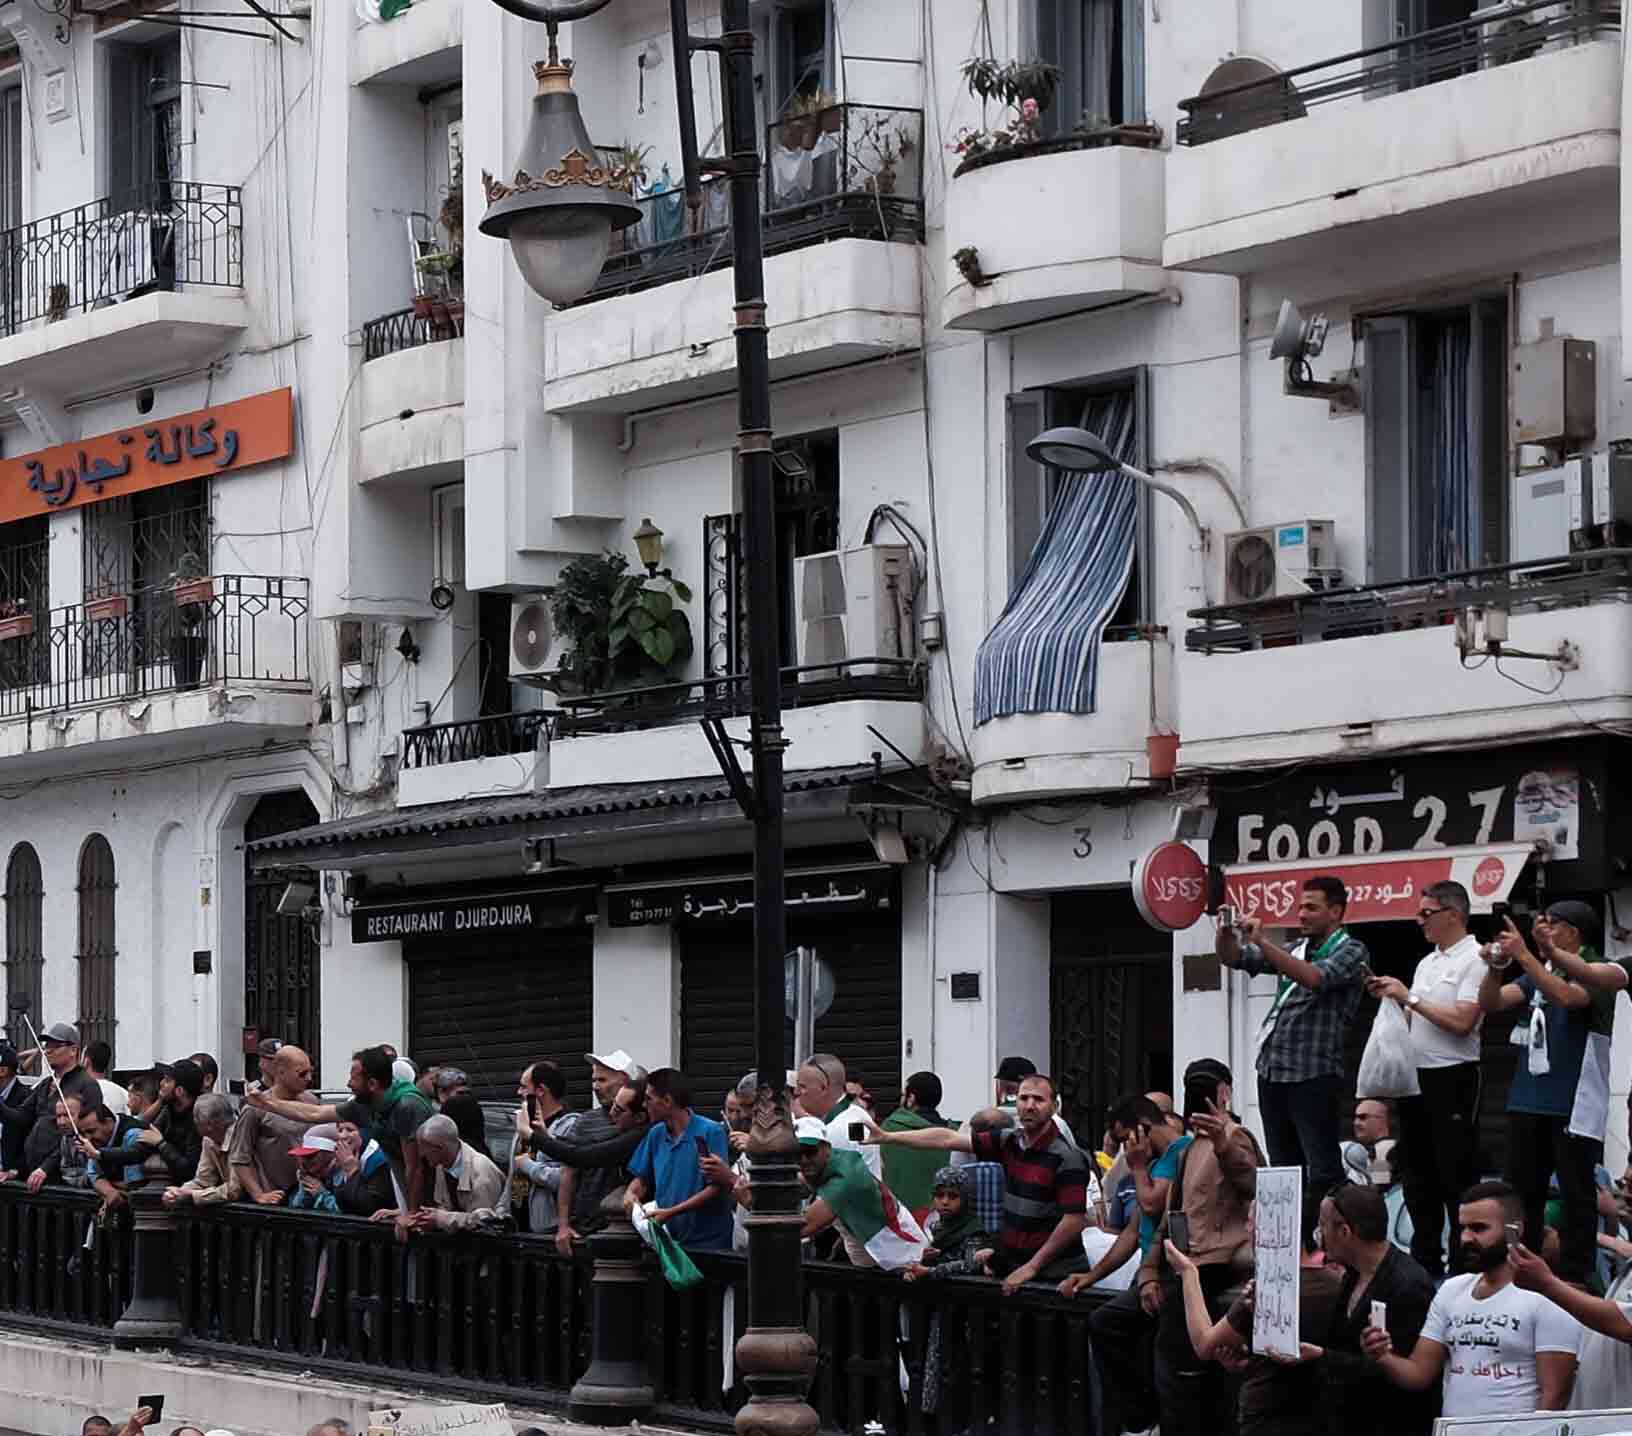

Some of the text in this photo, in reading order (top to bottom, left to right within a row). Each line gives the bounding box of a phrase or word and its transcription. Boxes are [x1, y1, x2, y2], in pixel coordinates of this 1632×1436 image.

[26, 418, 239, 505] وكالة تجارية
[1074, 827, 1091, 859] 3
[1237, 814, 1384, 864] FOOD
[367, 903, 532, 936] RESTAURANT DJURDJURA
